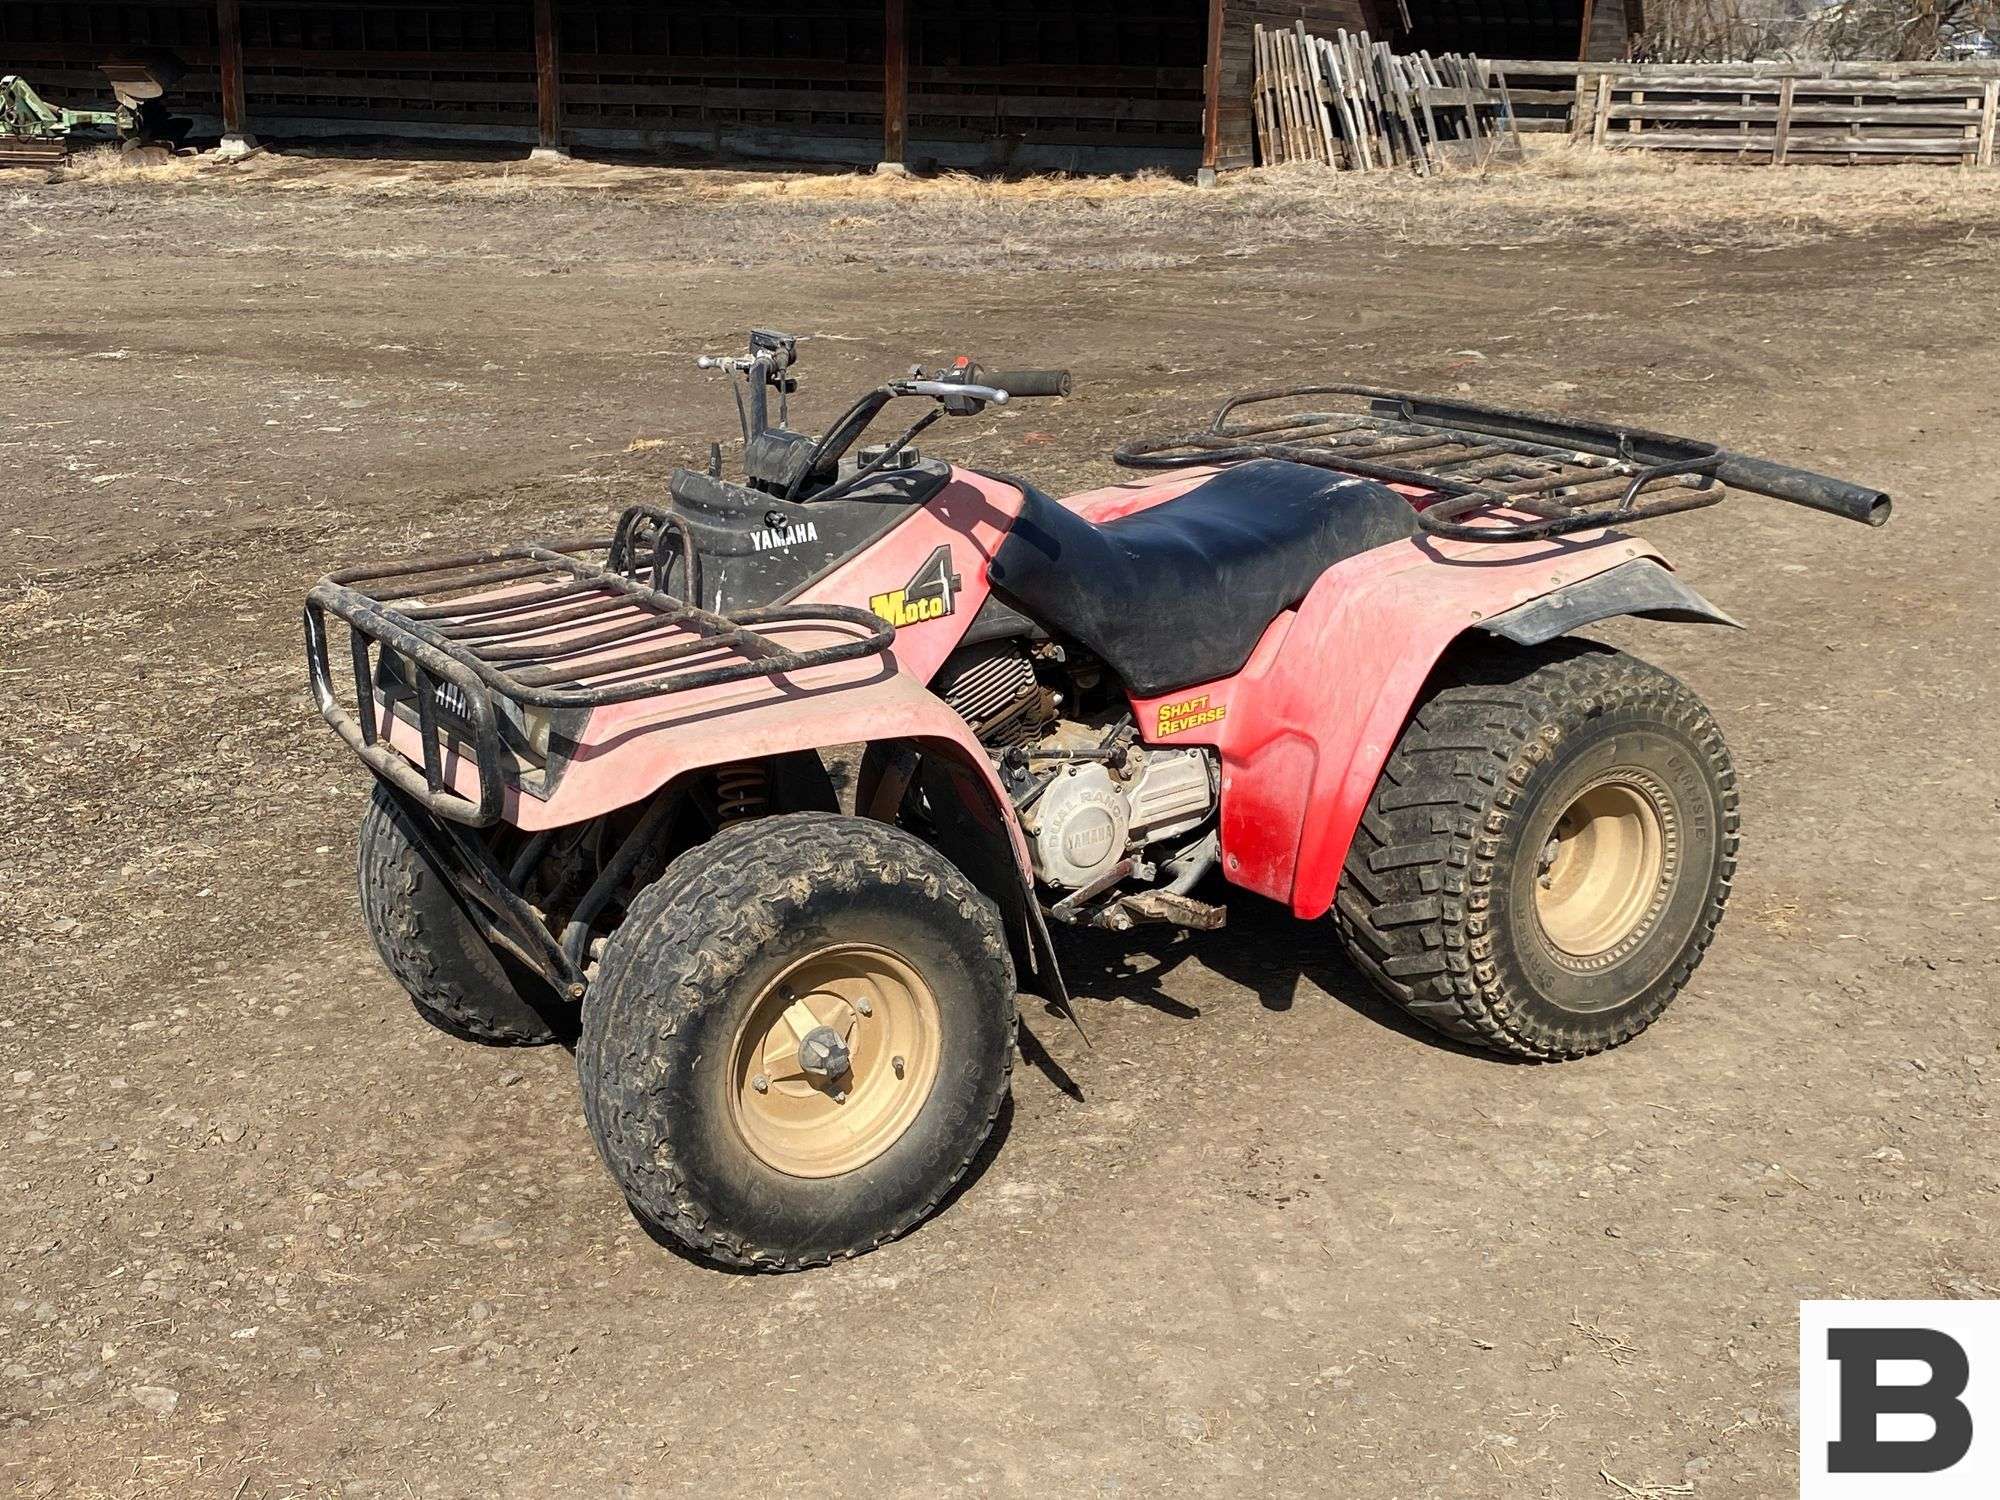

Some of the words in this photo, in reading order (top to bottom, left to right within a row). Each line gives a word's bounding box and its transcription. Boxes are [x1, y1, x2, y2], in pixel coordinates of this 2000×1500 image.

[750, 522, 818, 551] YAMAHA
[904, 544, 962, 616] 4
[869, 588, 945, 629] Moto
[1157, 705, 1226, 738] REVERSE
[1159, 695, 1210, 721] SHAFT
[1067, 824, 1113, 850] YAMAHA
